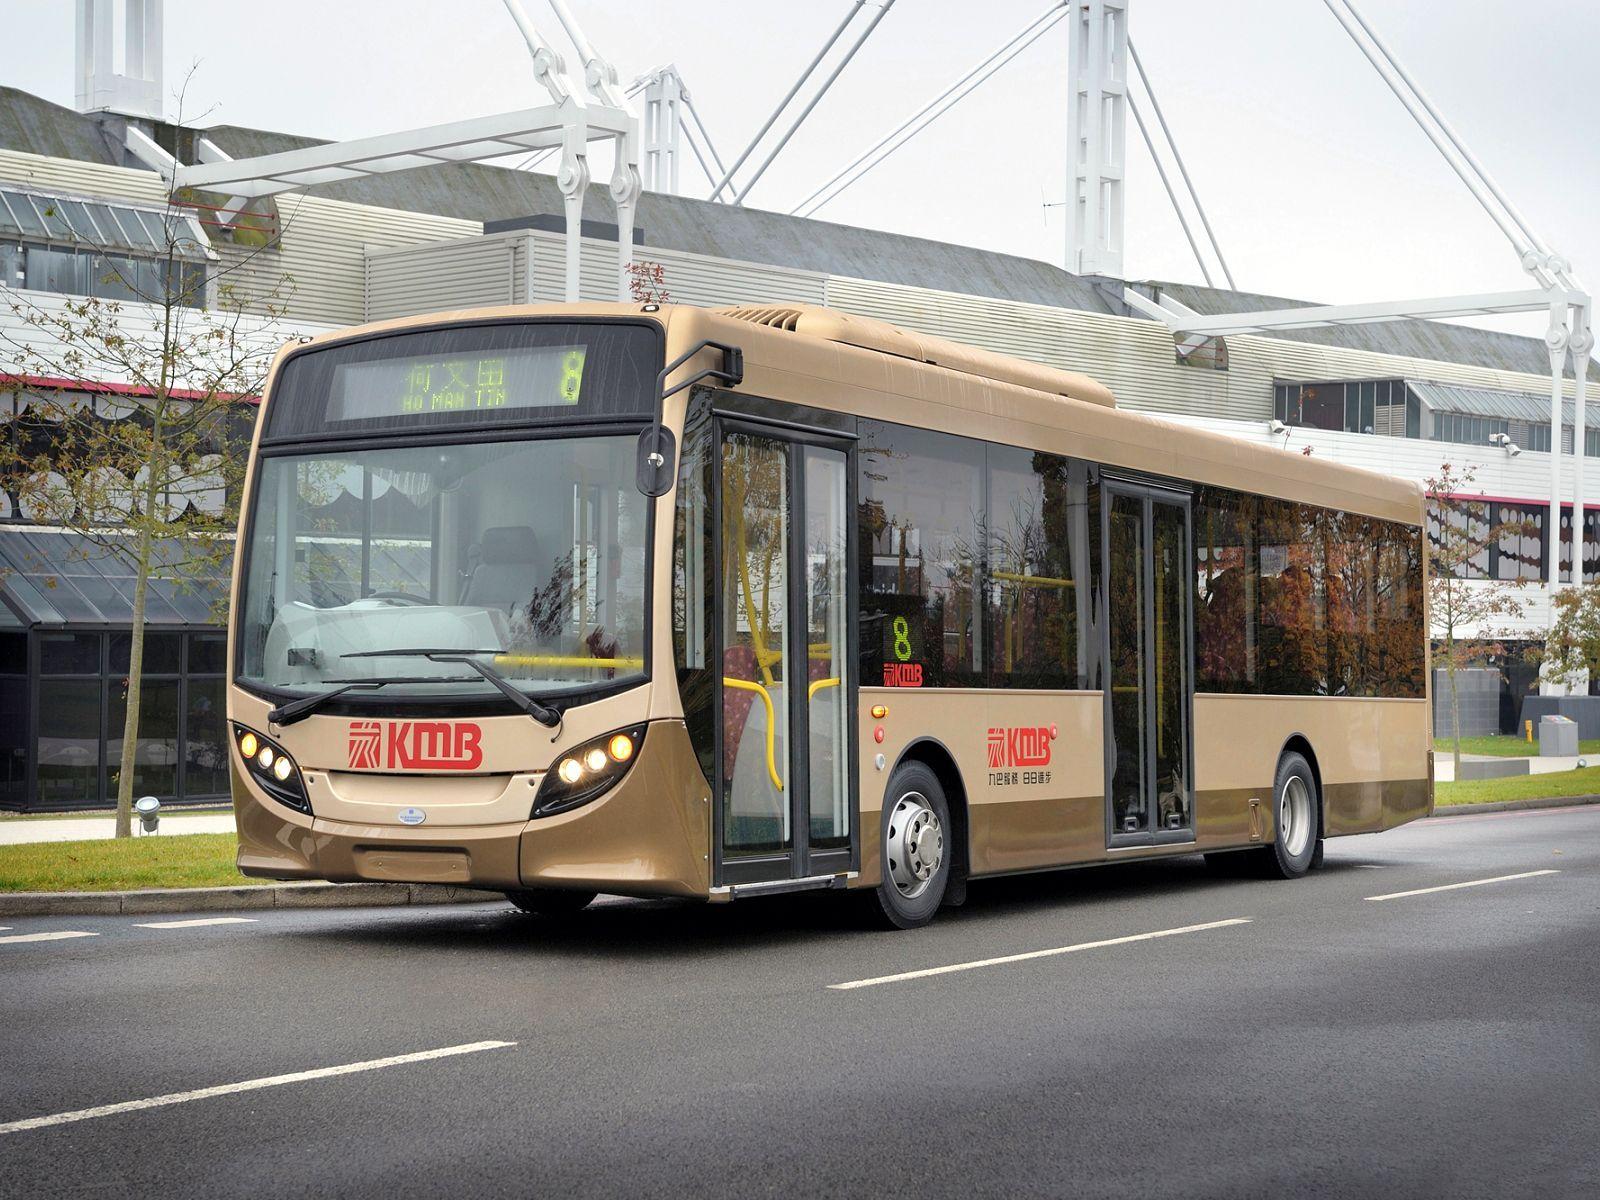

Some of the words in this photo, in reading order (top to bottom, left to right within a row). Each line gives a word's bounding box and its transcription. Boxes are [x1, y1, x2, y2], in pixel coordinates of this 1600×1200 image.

[893, 616, 912, 661] 8
[895, 663, 923, 687] KMB
[387, 722, 483, 770] KMB
[1007, 727, 1051, 767] KMB
